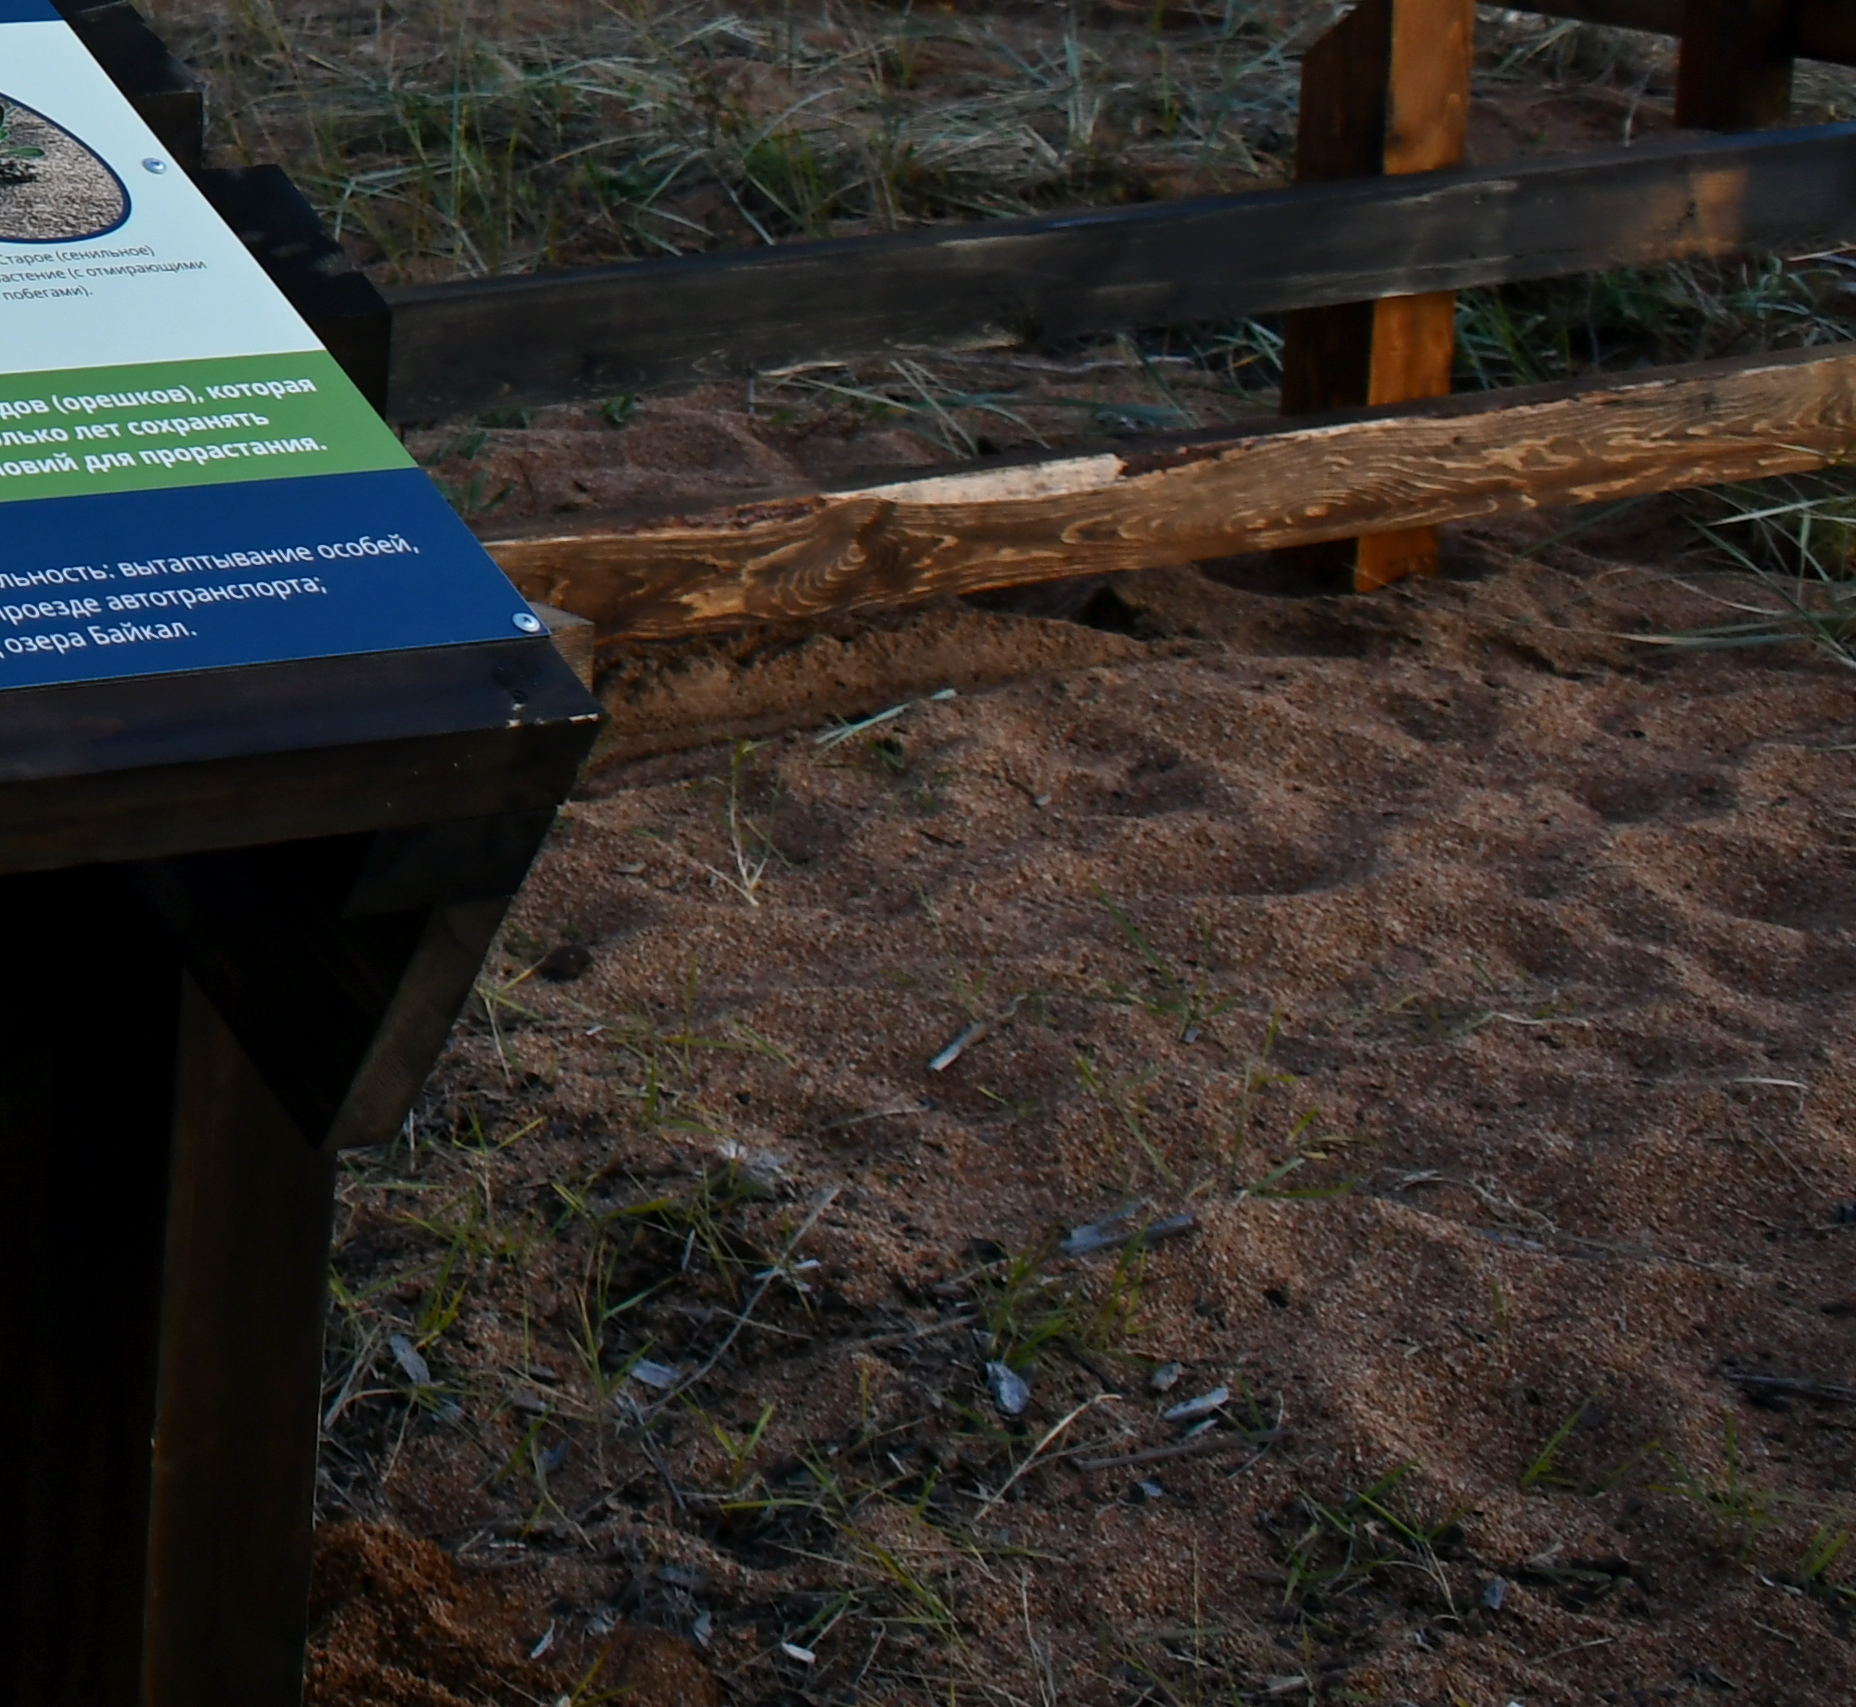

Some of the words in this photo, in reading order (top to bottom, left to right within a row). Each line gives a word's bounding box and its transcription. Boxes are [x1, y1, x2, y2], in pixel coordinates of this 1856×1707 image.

[55, 245, 155, 263] (сенильное)
[85, 260, 207, 277] отмирающими
[50, 384, 206, 416] (орешков),
[204, 377, 319, 401] которая
[73, 422, 122, 441] лет
[126, 411, 271, 438] сохранять
[83, 451, 138, 475] для
[137, 436, 329, 470] прорастания.
[116, 545, 316, 578] вытаптывание
[316, 532, 420, 560] особей,
[104, 576, 328, 612] автотранспорта;
[3, 631, 88, 655] озера
[86, 620, 198, 646] Байкал.
